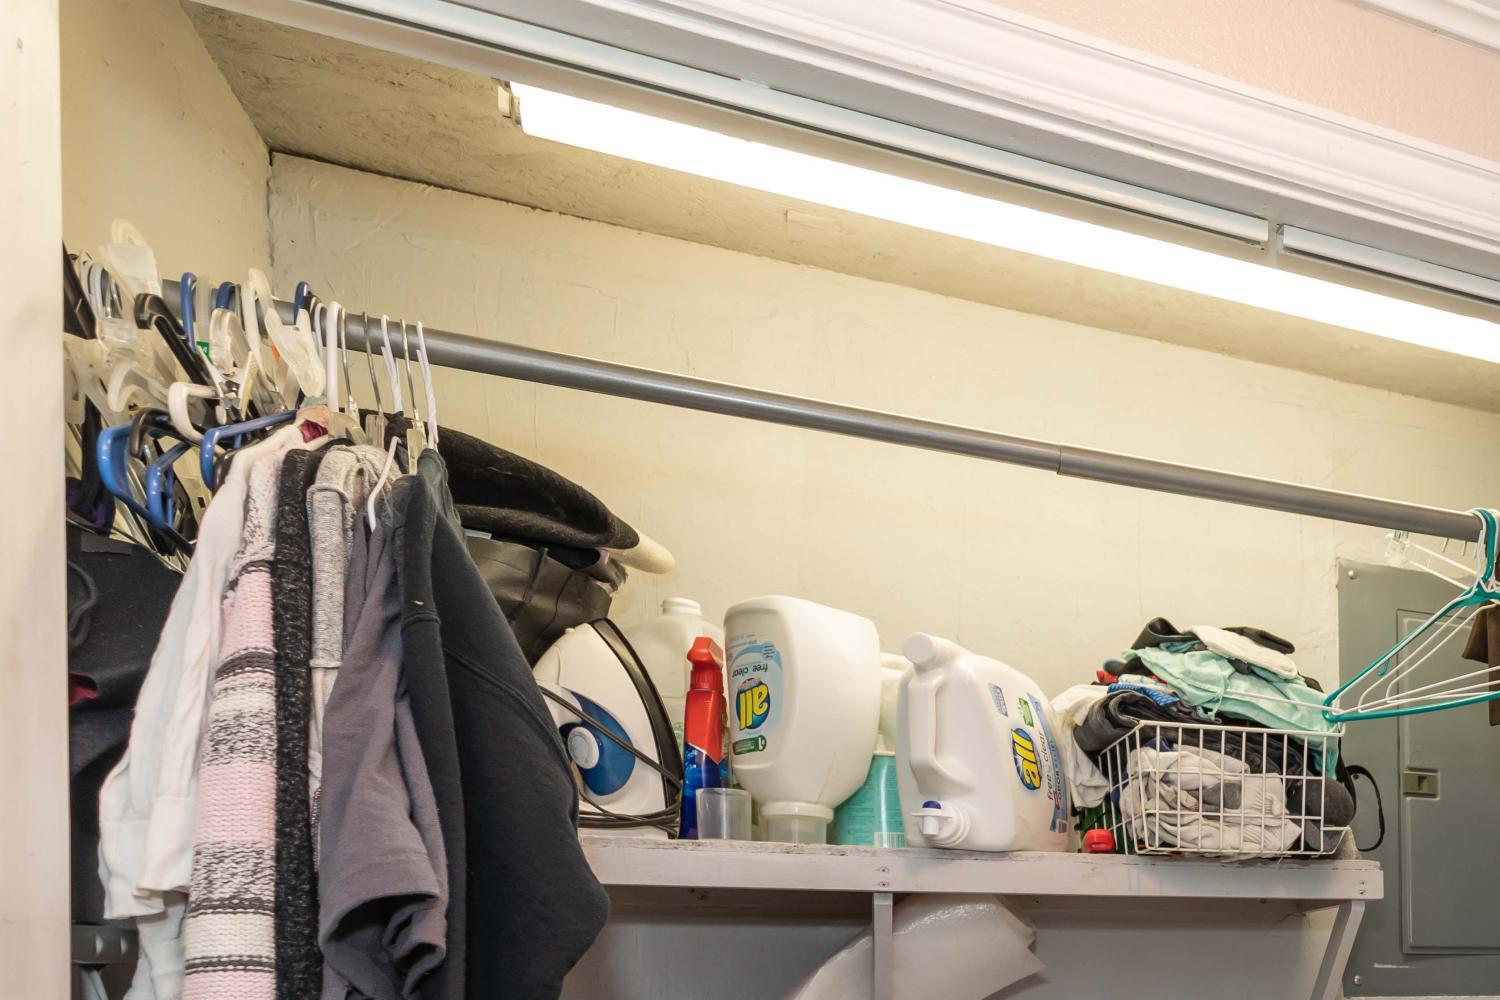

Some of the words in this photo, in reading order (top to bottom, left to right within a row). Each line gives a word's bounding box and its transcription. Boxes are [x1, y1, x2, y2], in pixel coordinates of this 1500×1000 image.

[752, 663, 768, 672] free
[738, 682, 769, 731] all
[1011, 728, 1042, 789] all
